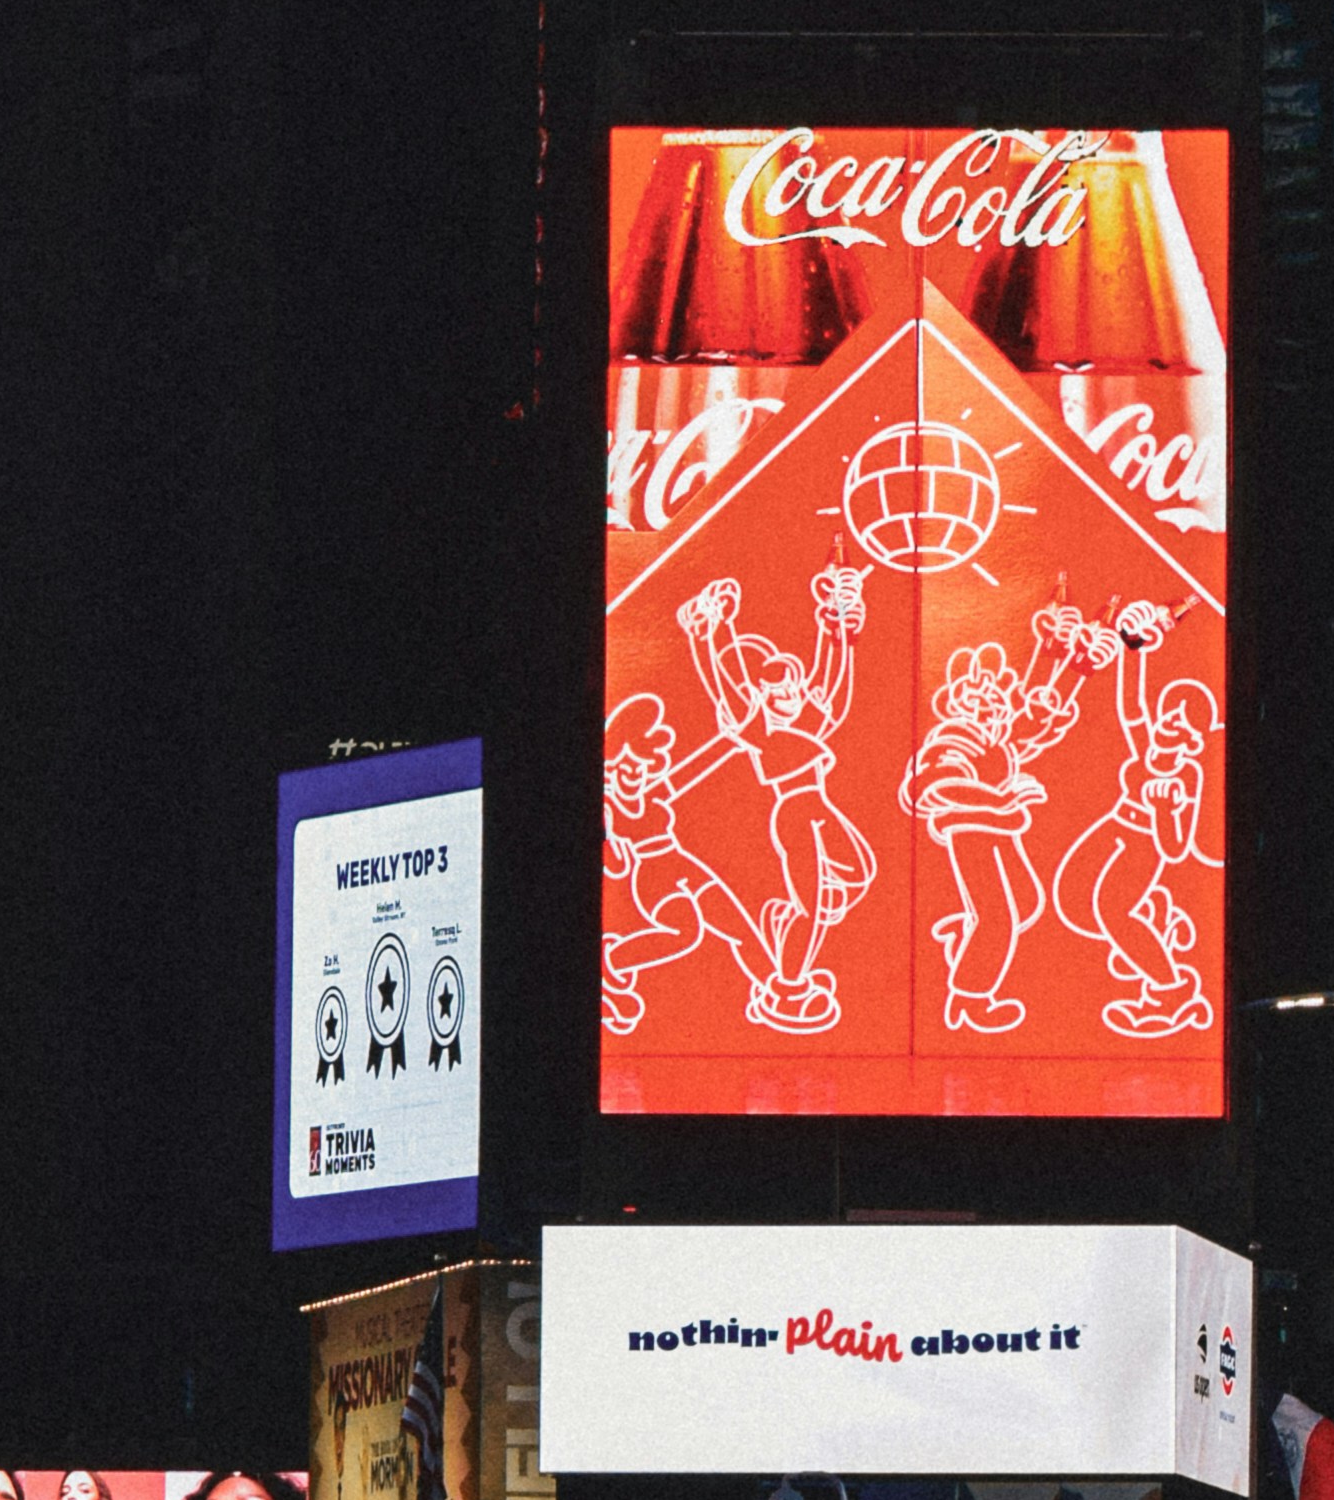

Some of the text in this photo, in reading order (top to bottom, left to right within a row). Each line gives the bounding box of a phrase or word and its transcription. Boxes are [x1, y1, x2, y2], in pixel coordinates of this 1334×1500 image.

[336, 845, 449, 890] WEEKLY TOP 3
[325, 1128, 375, 1156] TRIVIA
[325, 1153, 375, 1175] MOMENTS
[786, 1308, 904, 1364] plain
[911, 1325, 1042, 1357] about
[1049, 1324, 1082, 1351] it
